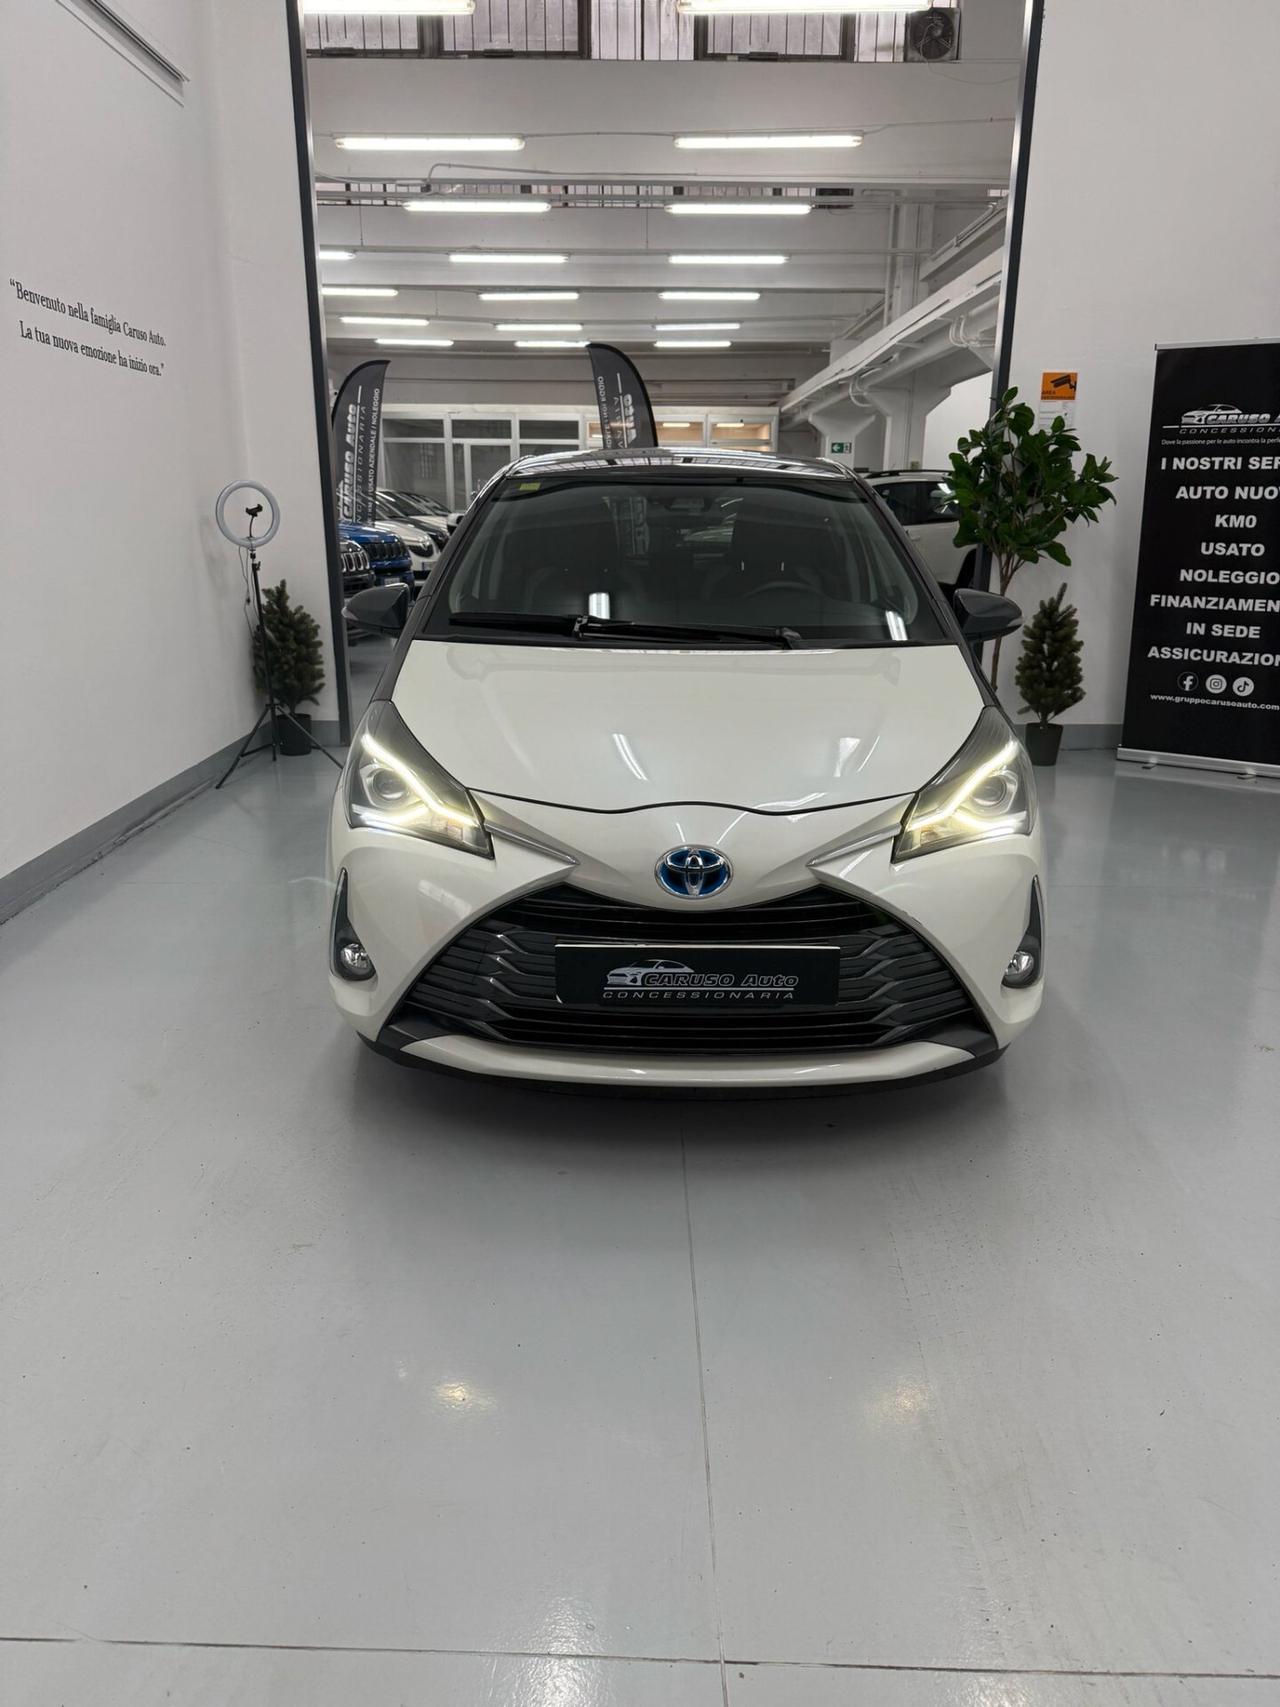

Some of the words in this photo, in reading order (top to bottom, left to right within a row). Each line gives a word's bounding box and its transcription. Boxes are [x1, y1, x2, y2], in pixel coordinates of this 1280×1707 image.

[68, 302, 89, 322] nella
[91, 307, 121, 335] famiglia
[123, 322, 147, 341] Caruso
[148, 330, 166, 346] Auto.
[19, 320, 32, 339] La
[35, 326, 50, 345] tua
[53, 334, 78, 353] nuova
[81, 344, 116, 364] emozione
[118, 350, 128, 367] ha
[129, 355, 147, 373] inizio
[372, 388, 380, 425] NOLEGGIO
[346, 403, 356, 447] Auto
[1206, 413, 1270, 425] CARUSO
[1179, 427, 1280, 435] CONCESSION
[369, 430, 377, 469] AZIENDALE
[1182, 439, 1205, 447] passione
[1206, 439, 1216, 447] per
[1161, 457, 1167, 470] I
[1172, 456, 1242, 470] NOSTRI
[344, 451, 354, 519] CARUSO
[1176, 486, 1229, 499] AUTO
[1234, 486, 1280, 500] NUO
[1214, 514, 1257, 528] KM0
[1200, 542, 1265, 556] USATO
[1180, 569, 1280, 585] NOLEGGIO
[1150, 594, 1280, 613] FINANZIAMEN
[1186, 622, 1206, 635] IN
[1211, 624, 1261, 639] SEDE
[1150, 694, 1280, 711] www.gruppocarusoauto.com
[644, 973, 735, 987] CARUSO
[740, 973, 799, 987] Auto
[603, 991, 795, 1000] CONCESSIONARIA
